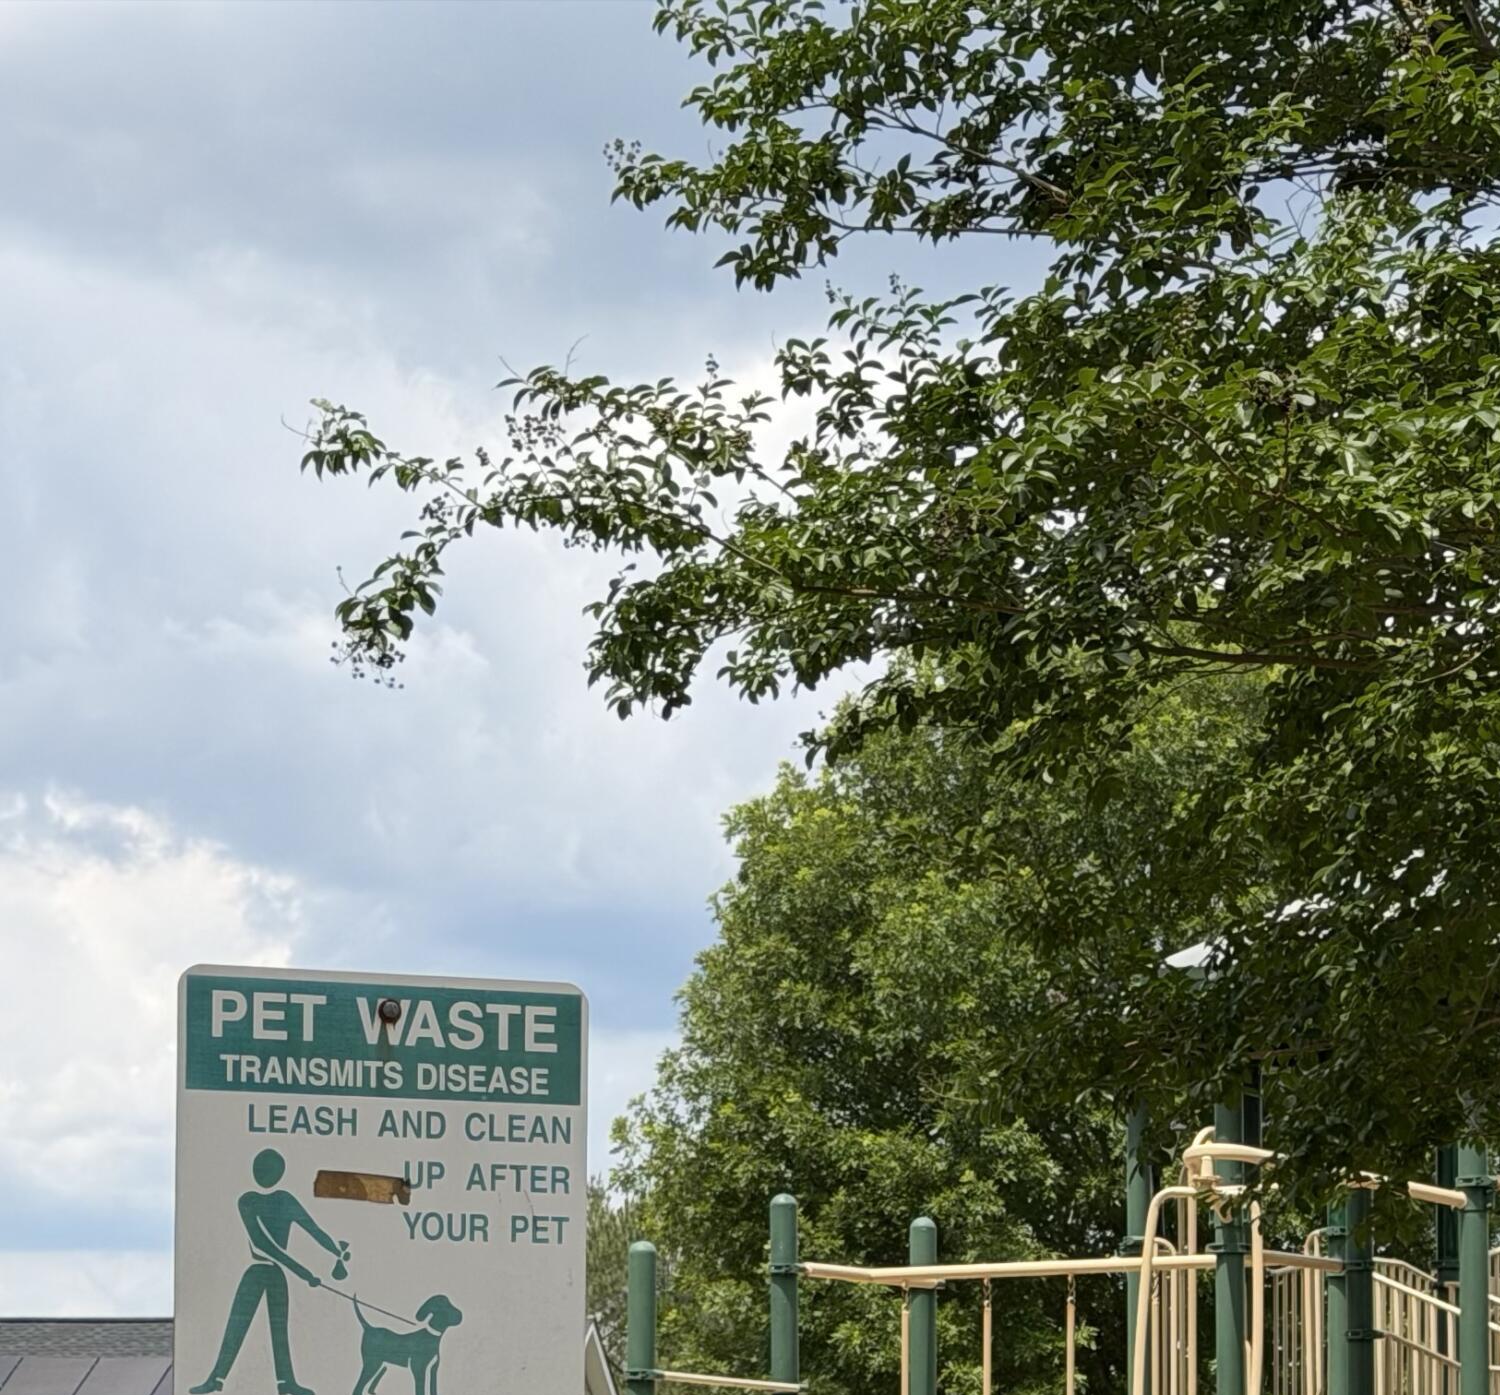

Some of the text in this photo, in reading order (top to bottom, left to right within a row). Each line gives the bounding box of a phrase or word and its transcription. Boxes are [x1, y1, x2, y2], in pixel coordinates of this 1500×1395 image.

[211, 989, 558, 1054] PET WASTE
[219, 1053, 550, 1096] TRANSMITS DISEASE
[247, 1103, 571, 1145] LEASH AND CLEAN
[402, 1160, 570, 1194] UP AFTER
[403, 1211, 570, 1245] YOUR PET
